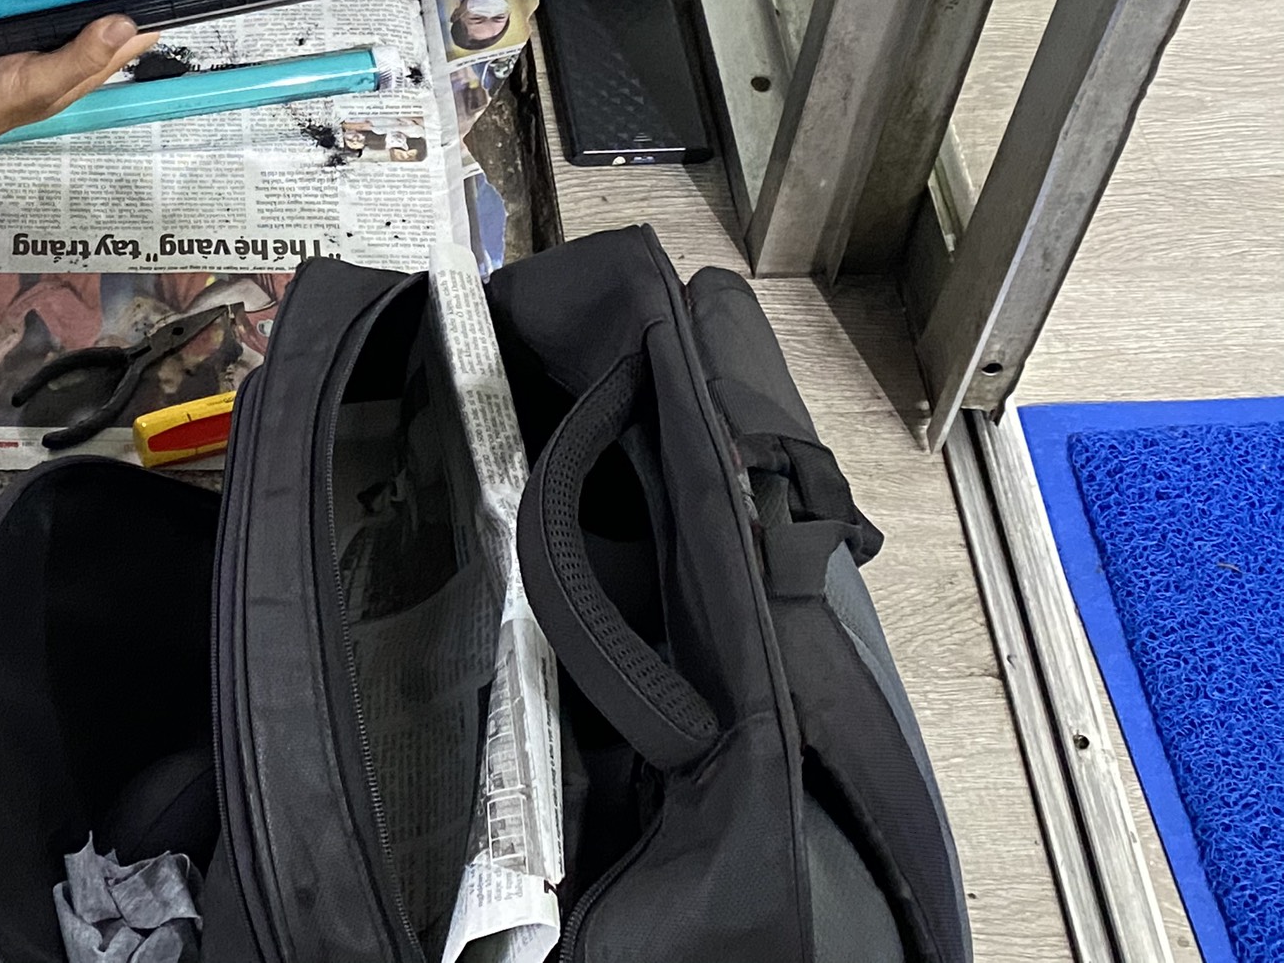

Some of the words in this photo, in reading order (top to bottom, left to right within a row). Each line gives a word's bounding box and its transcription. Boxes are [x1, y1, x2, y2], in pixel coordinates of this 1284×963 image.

[12, 233, 91, 263] trắng
[94, 234, 141, 260] tay
[145, 234, 231, 262] vàng"
[234, 236, 268, 260] hệ
